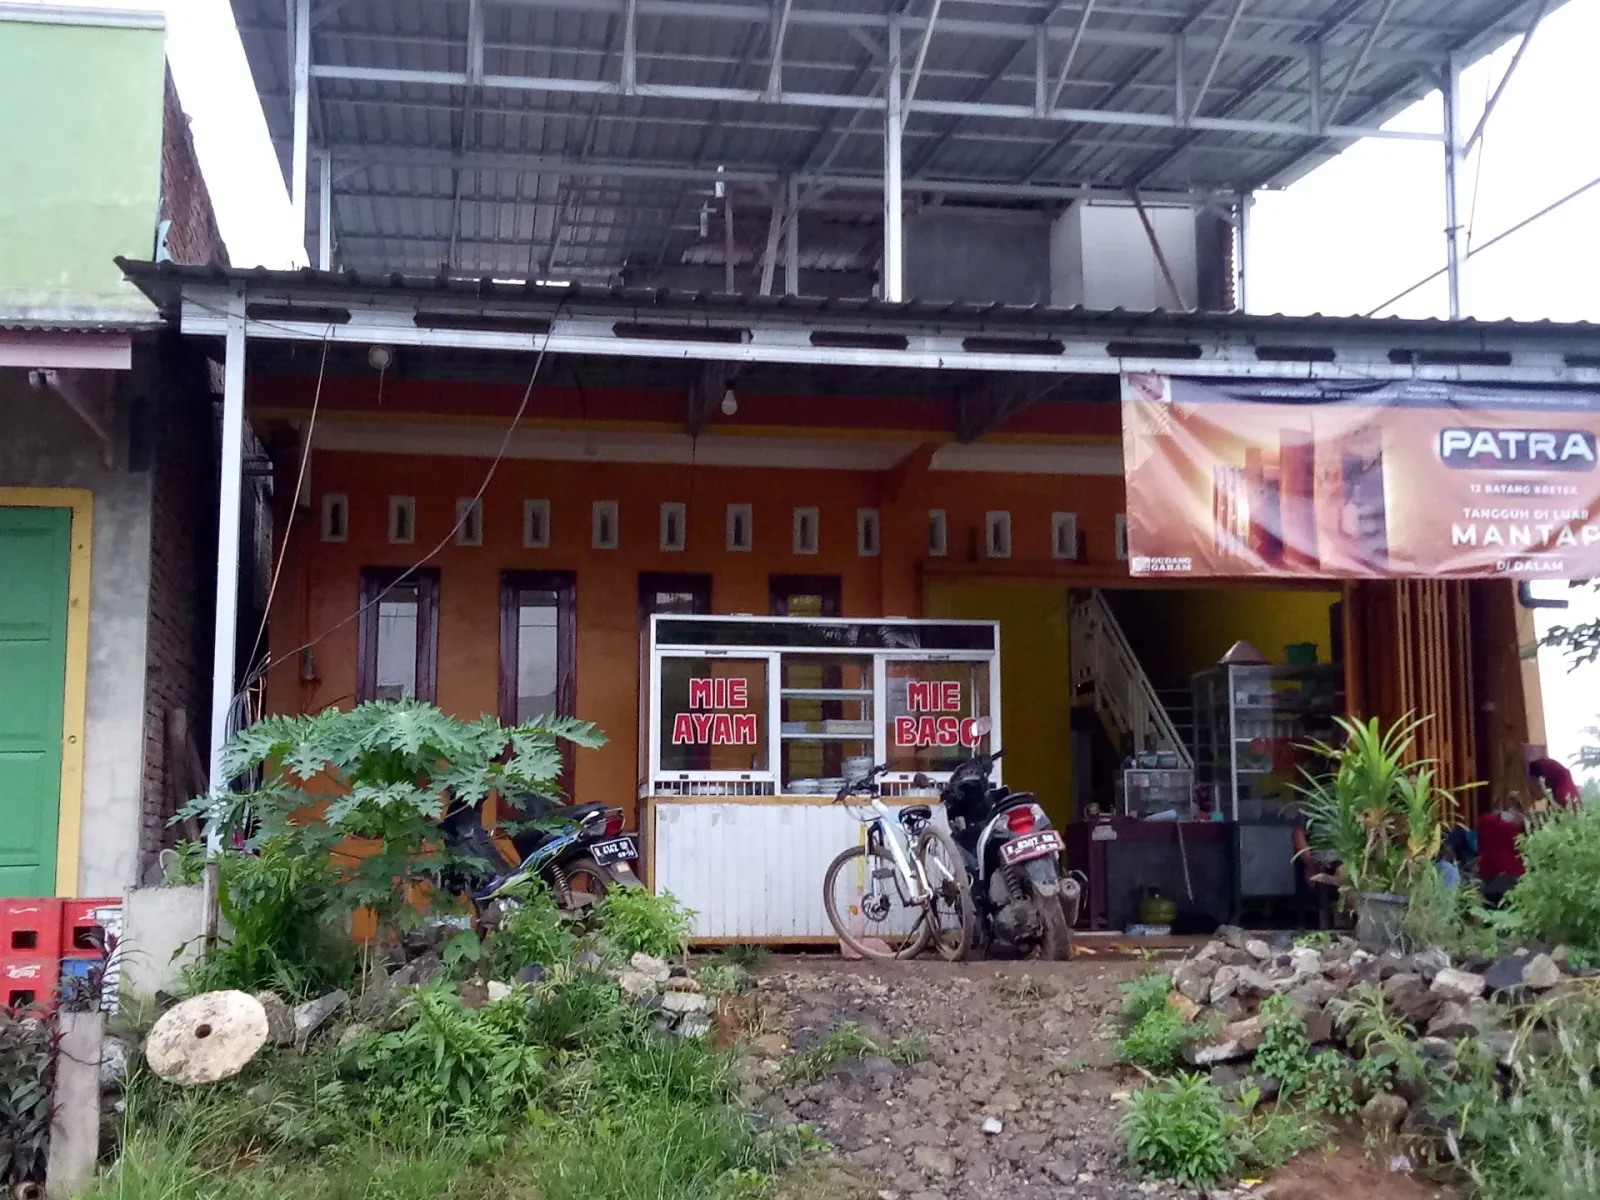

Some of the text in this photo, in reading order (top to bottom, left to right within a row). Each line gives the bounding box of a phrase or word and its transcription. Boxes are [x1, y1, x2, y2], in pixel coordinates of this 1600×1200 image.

[1442, 430, 1594, 461] PATRA
[1470, 484, 1481, 494] 12
[1485, 484, 1530, 495] BATANG
[1462, 507, 1530, 519] TANGGUH
[1451, 523, 1600, 546] MANTAP
[1151, 563, 1192, 571] GARAM
[1513, 561, 1564, 572] DALAM
[689, 678, 748, 710] MIE
[906, 681, 962, 712] MIE
[672, 713, 757, 746] AYAM
